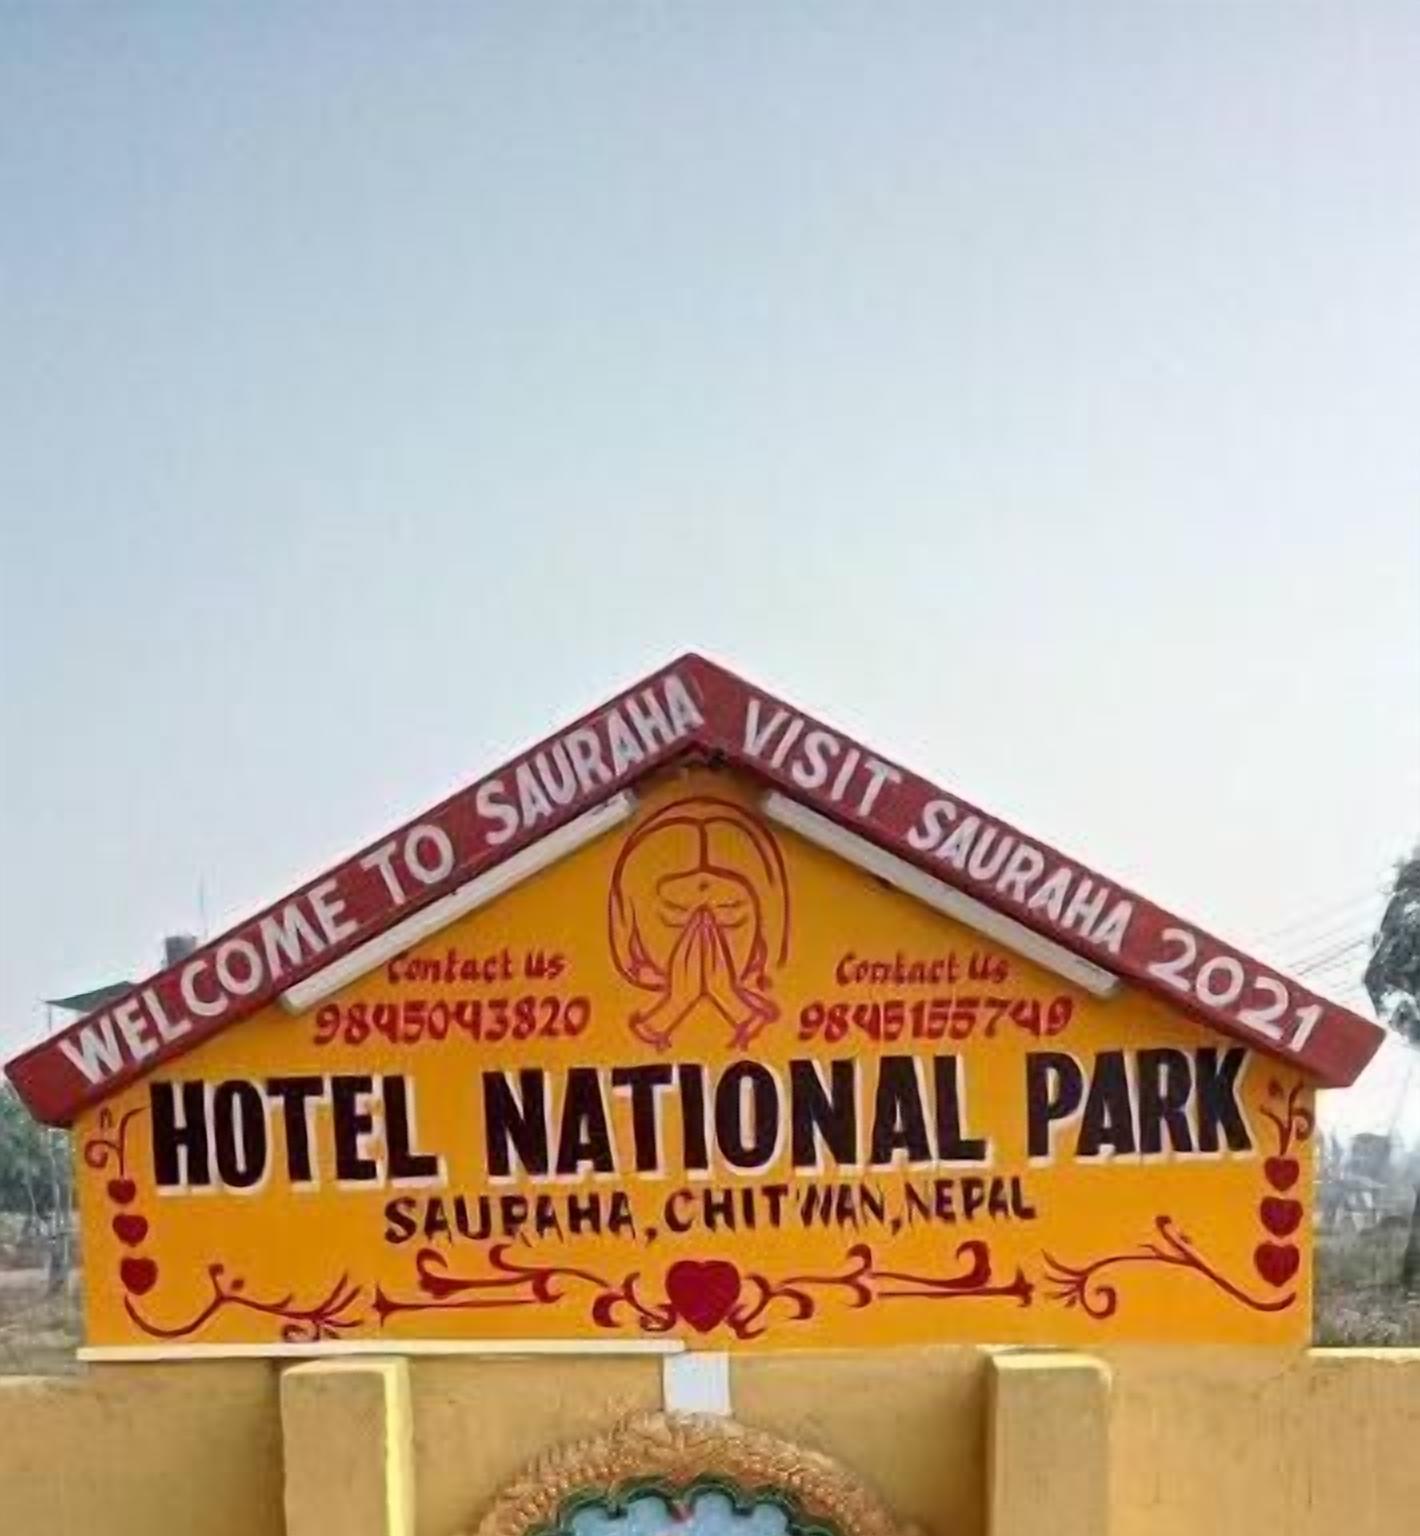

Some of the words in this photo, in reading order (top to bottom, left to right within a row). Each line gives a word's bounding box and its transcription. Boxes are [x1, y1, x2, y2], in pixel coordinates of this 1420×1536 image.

[59, 880, 361, 1086] WELCOME
[361, 825, 454, 905] TO
[475, 675, 705, 846] SAURAHA
[743, 699, 901, 817] VISIT
[906, 799, 1133, 955] SAURAHA
[1147, 927, 1326, 1053] 2021
[387, 948, 513, 985] Contact
[835, 950, 960, 985] Contact
[313, 997, 591, 1045] 9845043820
[797, 995, 1074, 1043] 9845155749
[149, 1074, 445, 1192] HOTEL
[481, 1054, 987, 1184] NATIONAL
[1025, 1046, 1254, 1164] PARK
